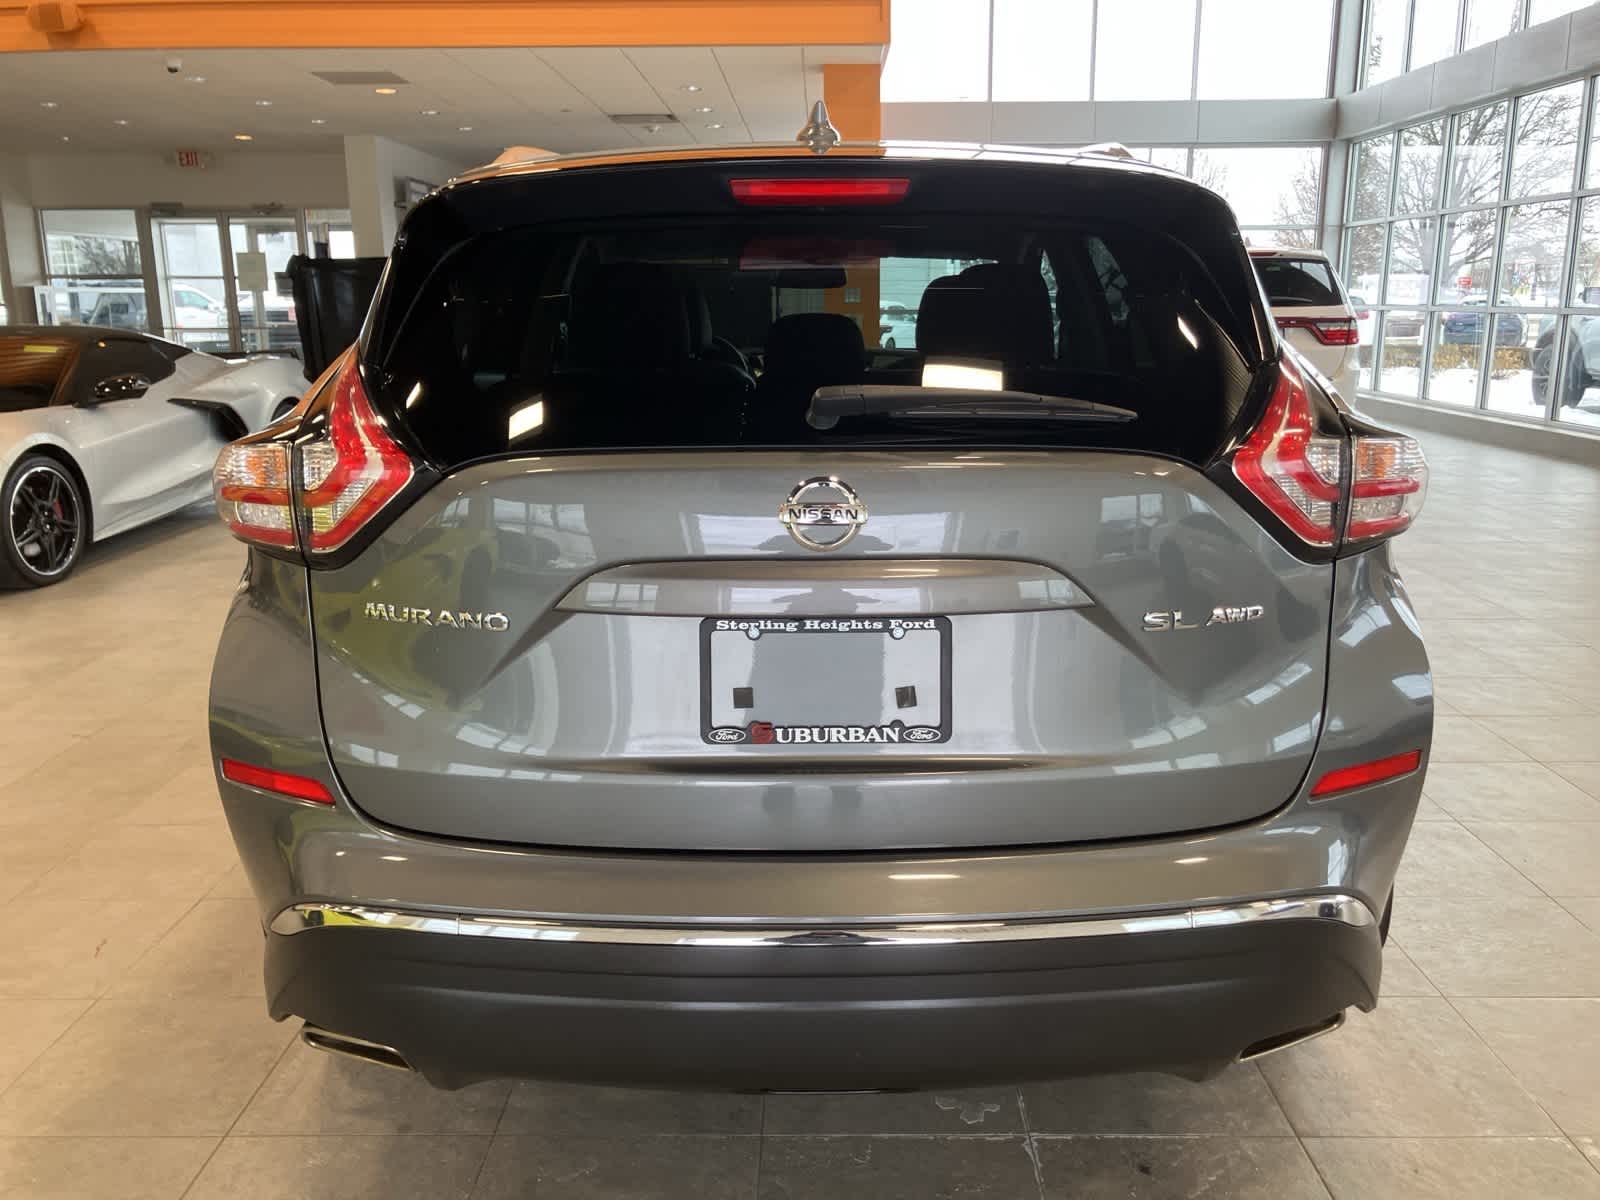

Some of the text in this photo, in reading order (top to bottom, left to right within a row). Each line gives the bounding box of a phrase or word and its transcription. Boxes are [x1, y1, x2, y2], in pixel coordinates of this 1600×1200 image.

[788, 508, 859, 520] NISSAN
[364, 602, 509, 631] MURANO
[1143, 605, 1264, 632] SL AWD
[715, 619, 937, 632] Sterling Heights Ford
[712, 728, 741, 743] Ford
[751, 722, 900, 744] SUBURBAN
[908, 728, 936, 742] Ford
